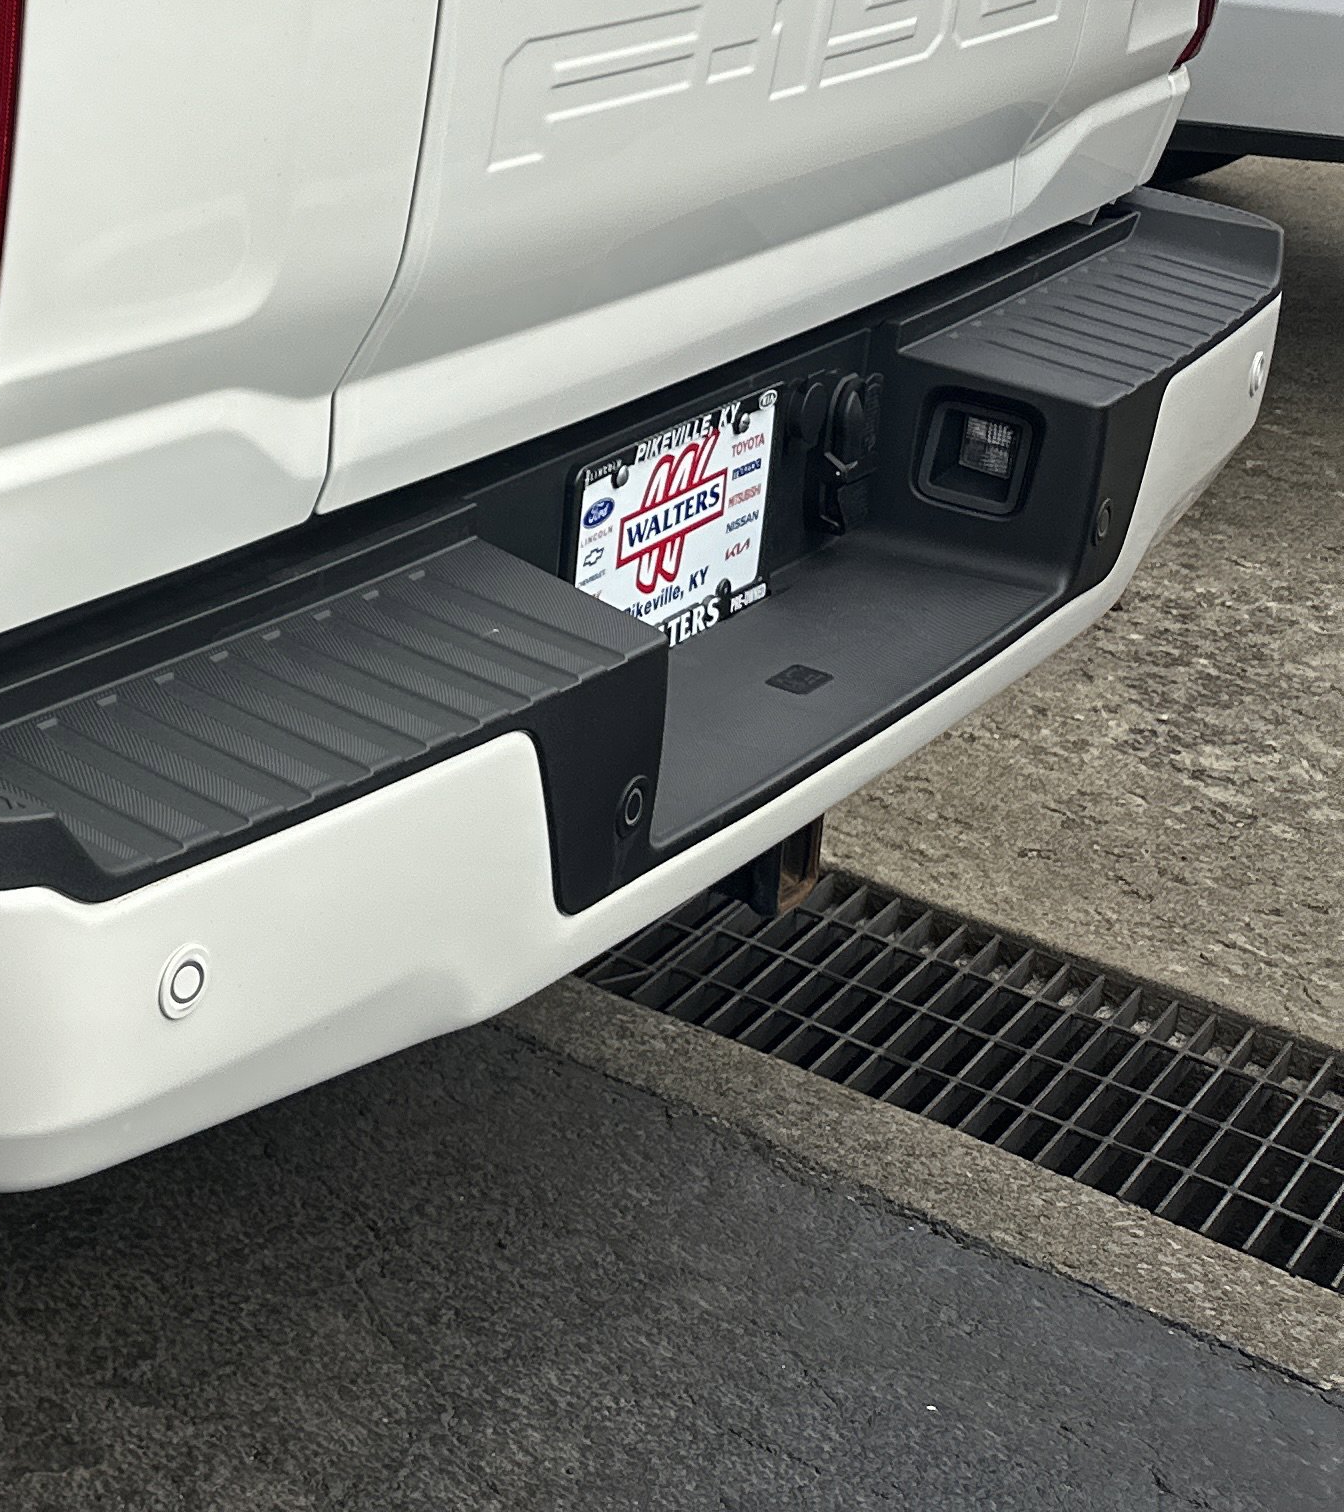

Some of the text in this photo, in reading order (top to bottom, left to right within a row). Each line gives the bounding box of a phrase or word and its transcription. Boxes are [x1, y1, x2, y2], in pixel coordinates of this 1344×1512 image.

[718, 401, 741, 428] KY
[732, 433, 765, 457] TOYOTA
[627, 483, 720, 547] WALTERS
[726, 510, 759, 533] NISSAN
[688, 566, 709, 592] KY
